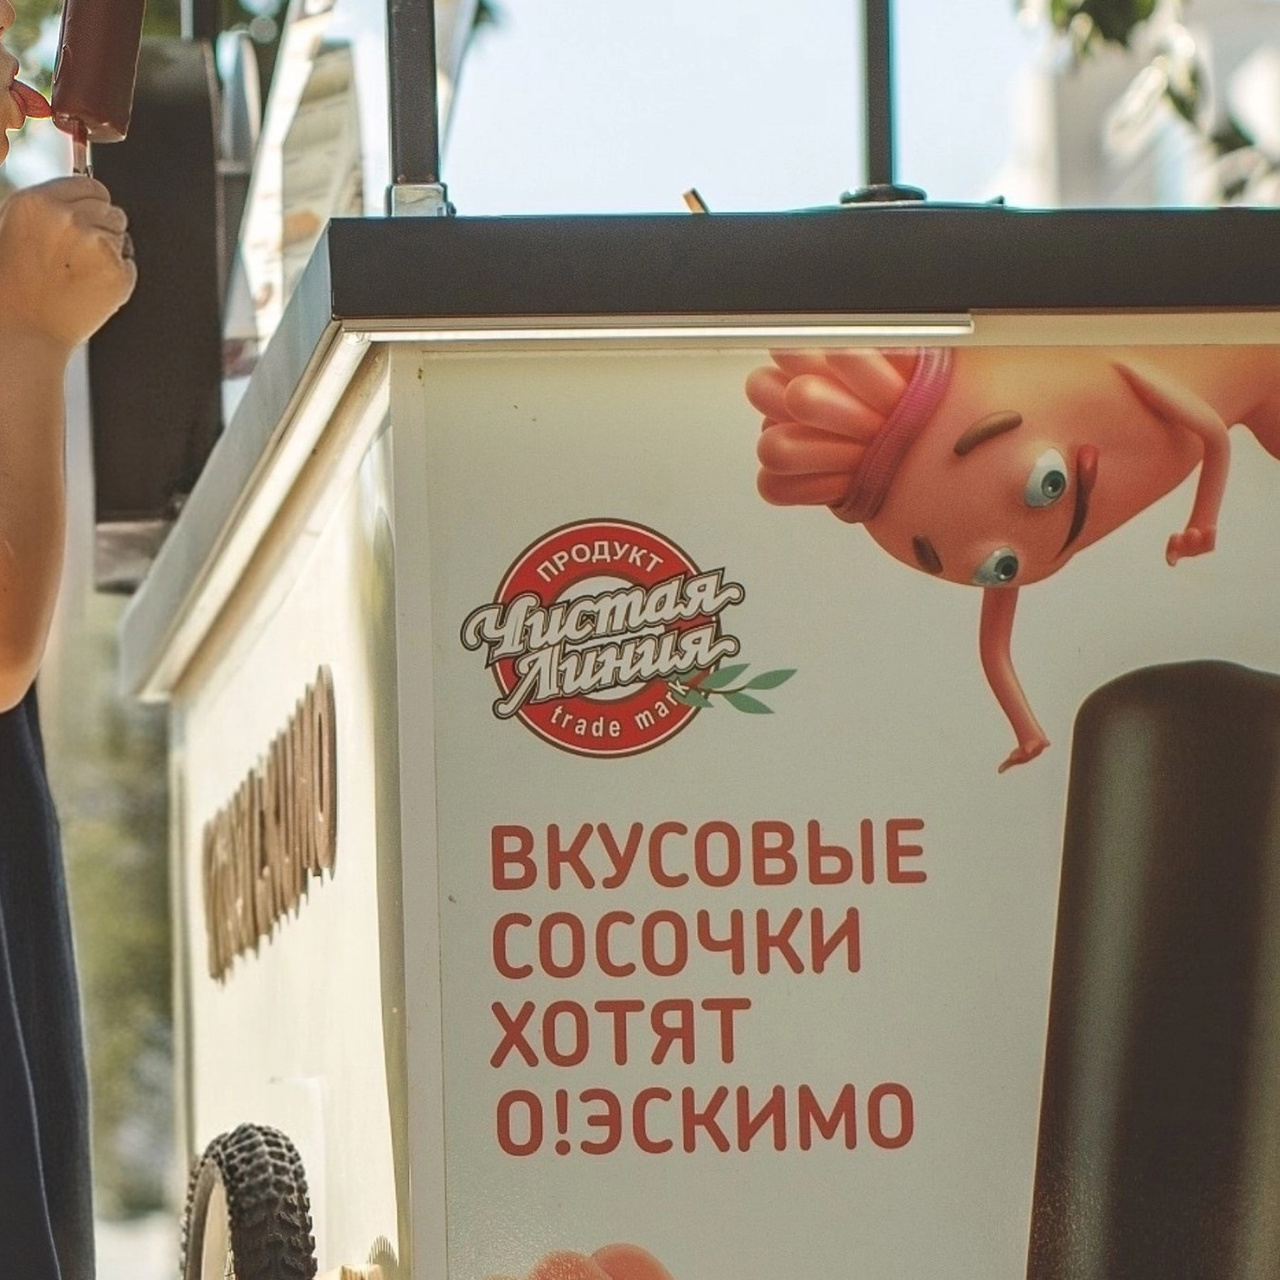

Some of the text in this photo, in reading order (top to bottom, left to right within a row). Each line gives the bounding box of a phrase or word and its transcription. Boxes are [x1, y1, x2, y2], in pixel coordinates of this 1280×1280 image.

[535, 540, 664, 583] ПРОДУКТ
[461, 567, 745, 668] Чистая
[493, 623, 741, 719] Линия
[549, 680, 690, 738] trade mark
[490, 818, 927, 891] ВКУСОВЫЕ
[492, 906, 861, 980] СОСОЧКИ
[489, 997, 752, 1068] ХОТЯТ
[496, 1082, 915, 1157] О!ЭСКИМО
